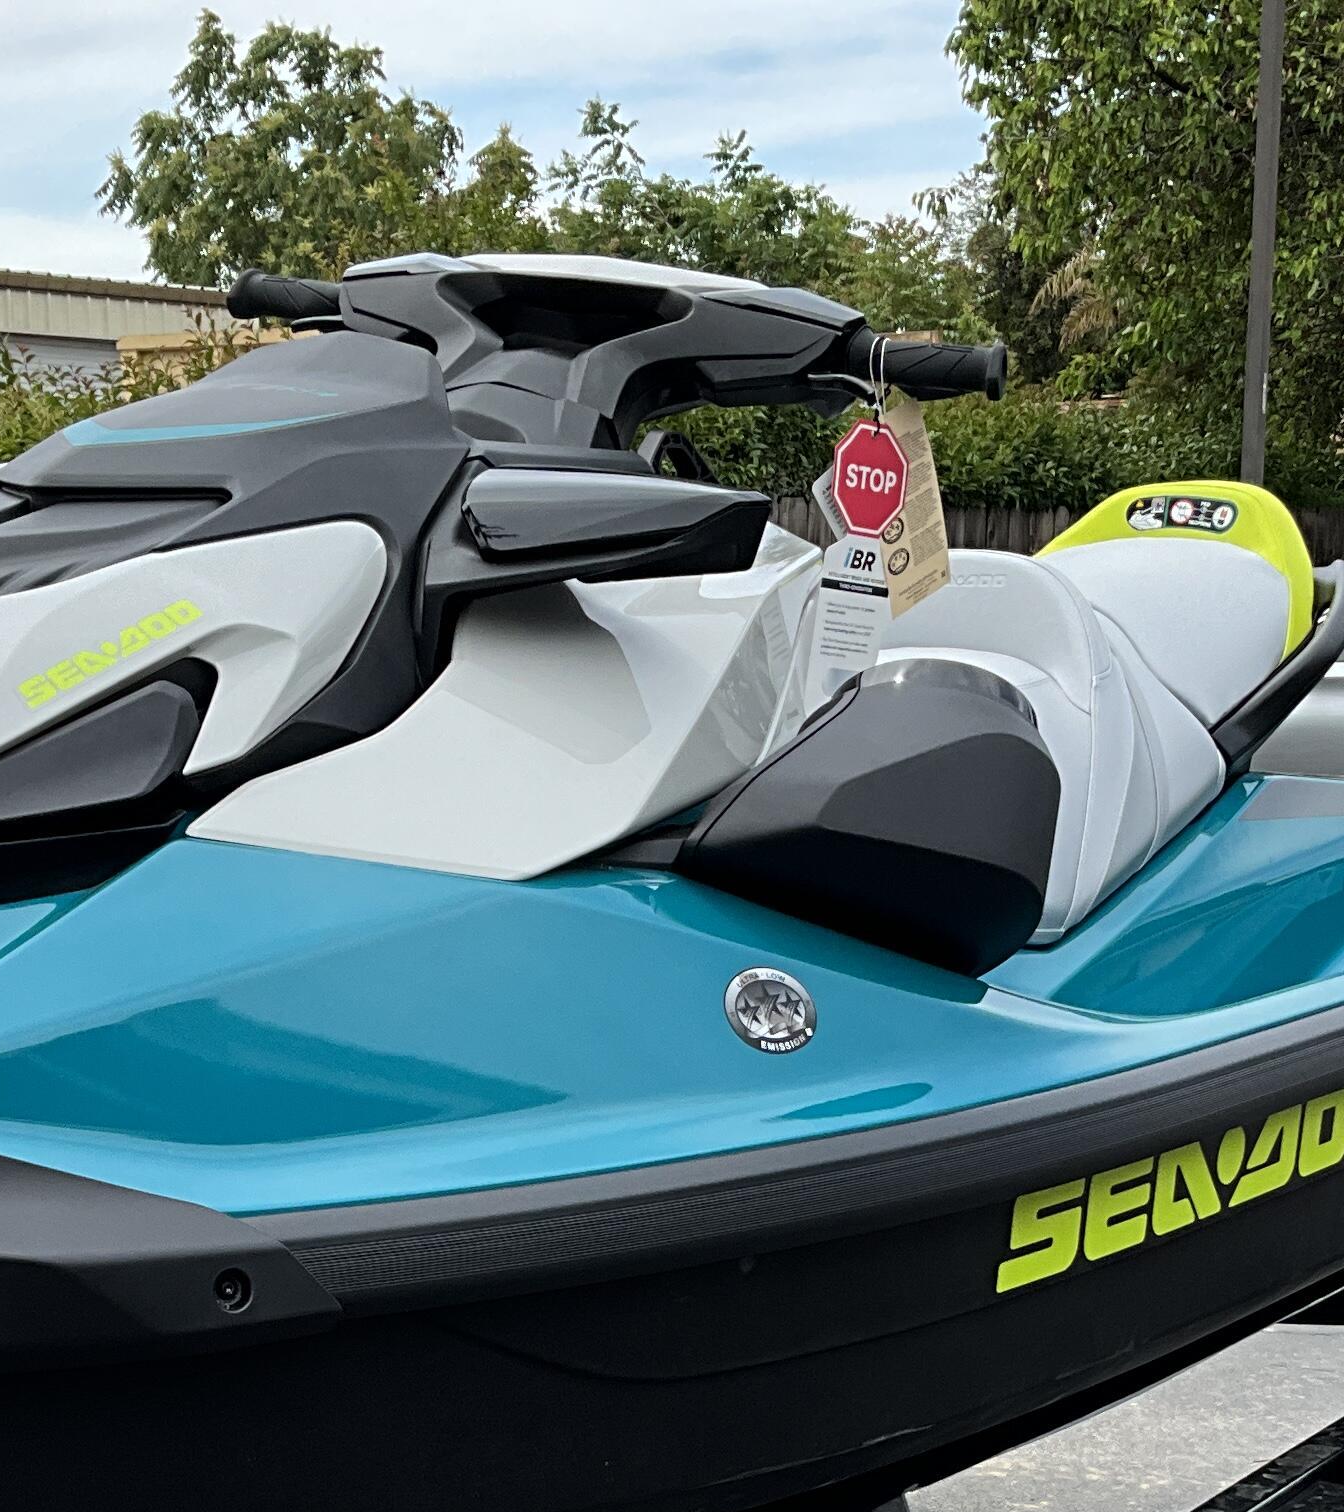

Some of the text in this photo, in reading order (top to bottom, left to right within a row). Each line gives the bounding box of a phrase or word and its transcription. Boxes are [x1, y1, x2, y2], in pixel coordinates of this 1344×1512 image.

[845, 463, 897, 494] STOP
[843, 546, 876, 572] iBR
[760, 1034, 807, 1053] EMISSION
